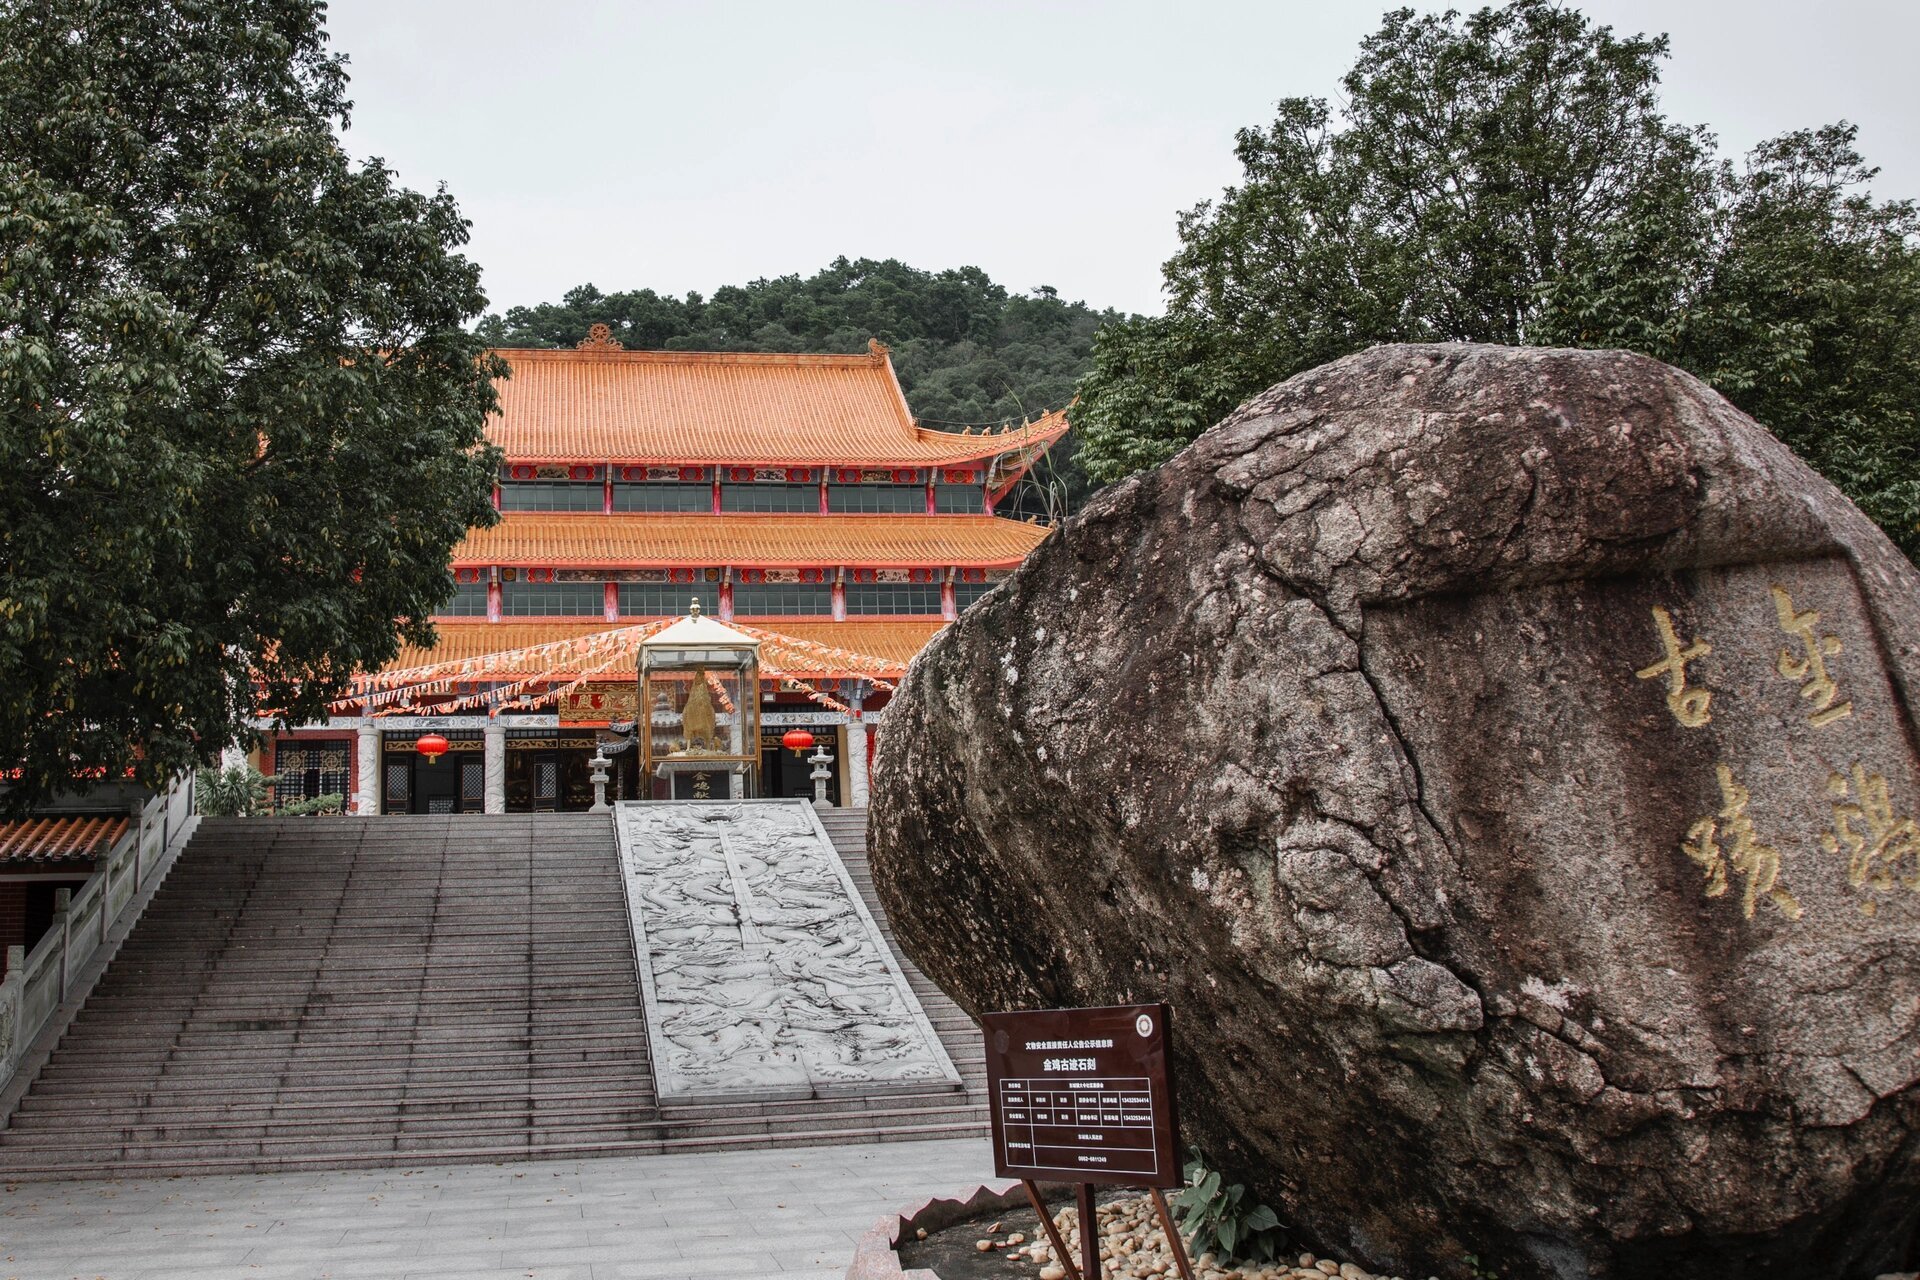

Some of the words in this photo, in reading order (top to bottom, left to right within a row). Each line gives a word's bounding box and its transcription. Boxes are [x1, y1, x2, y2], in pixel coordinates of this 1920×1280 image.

[1043, 1058, 1096, 1071] 金鸡古迹石刻
